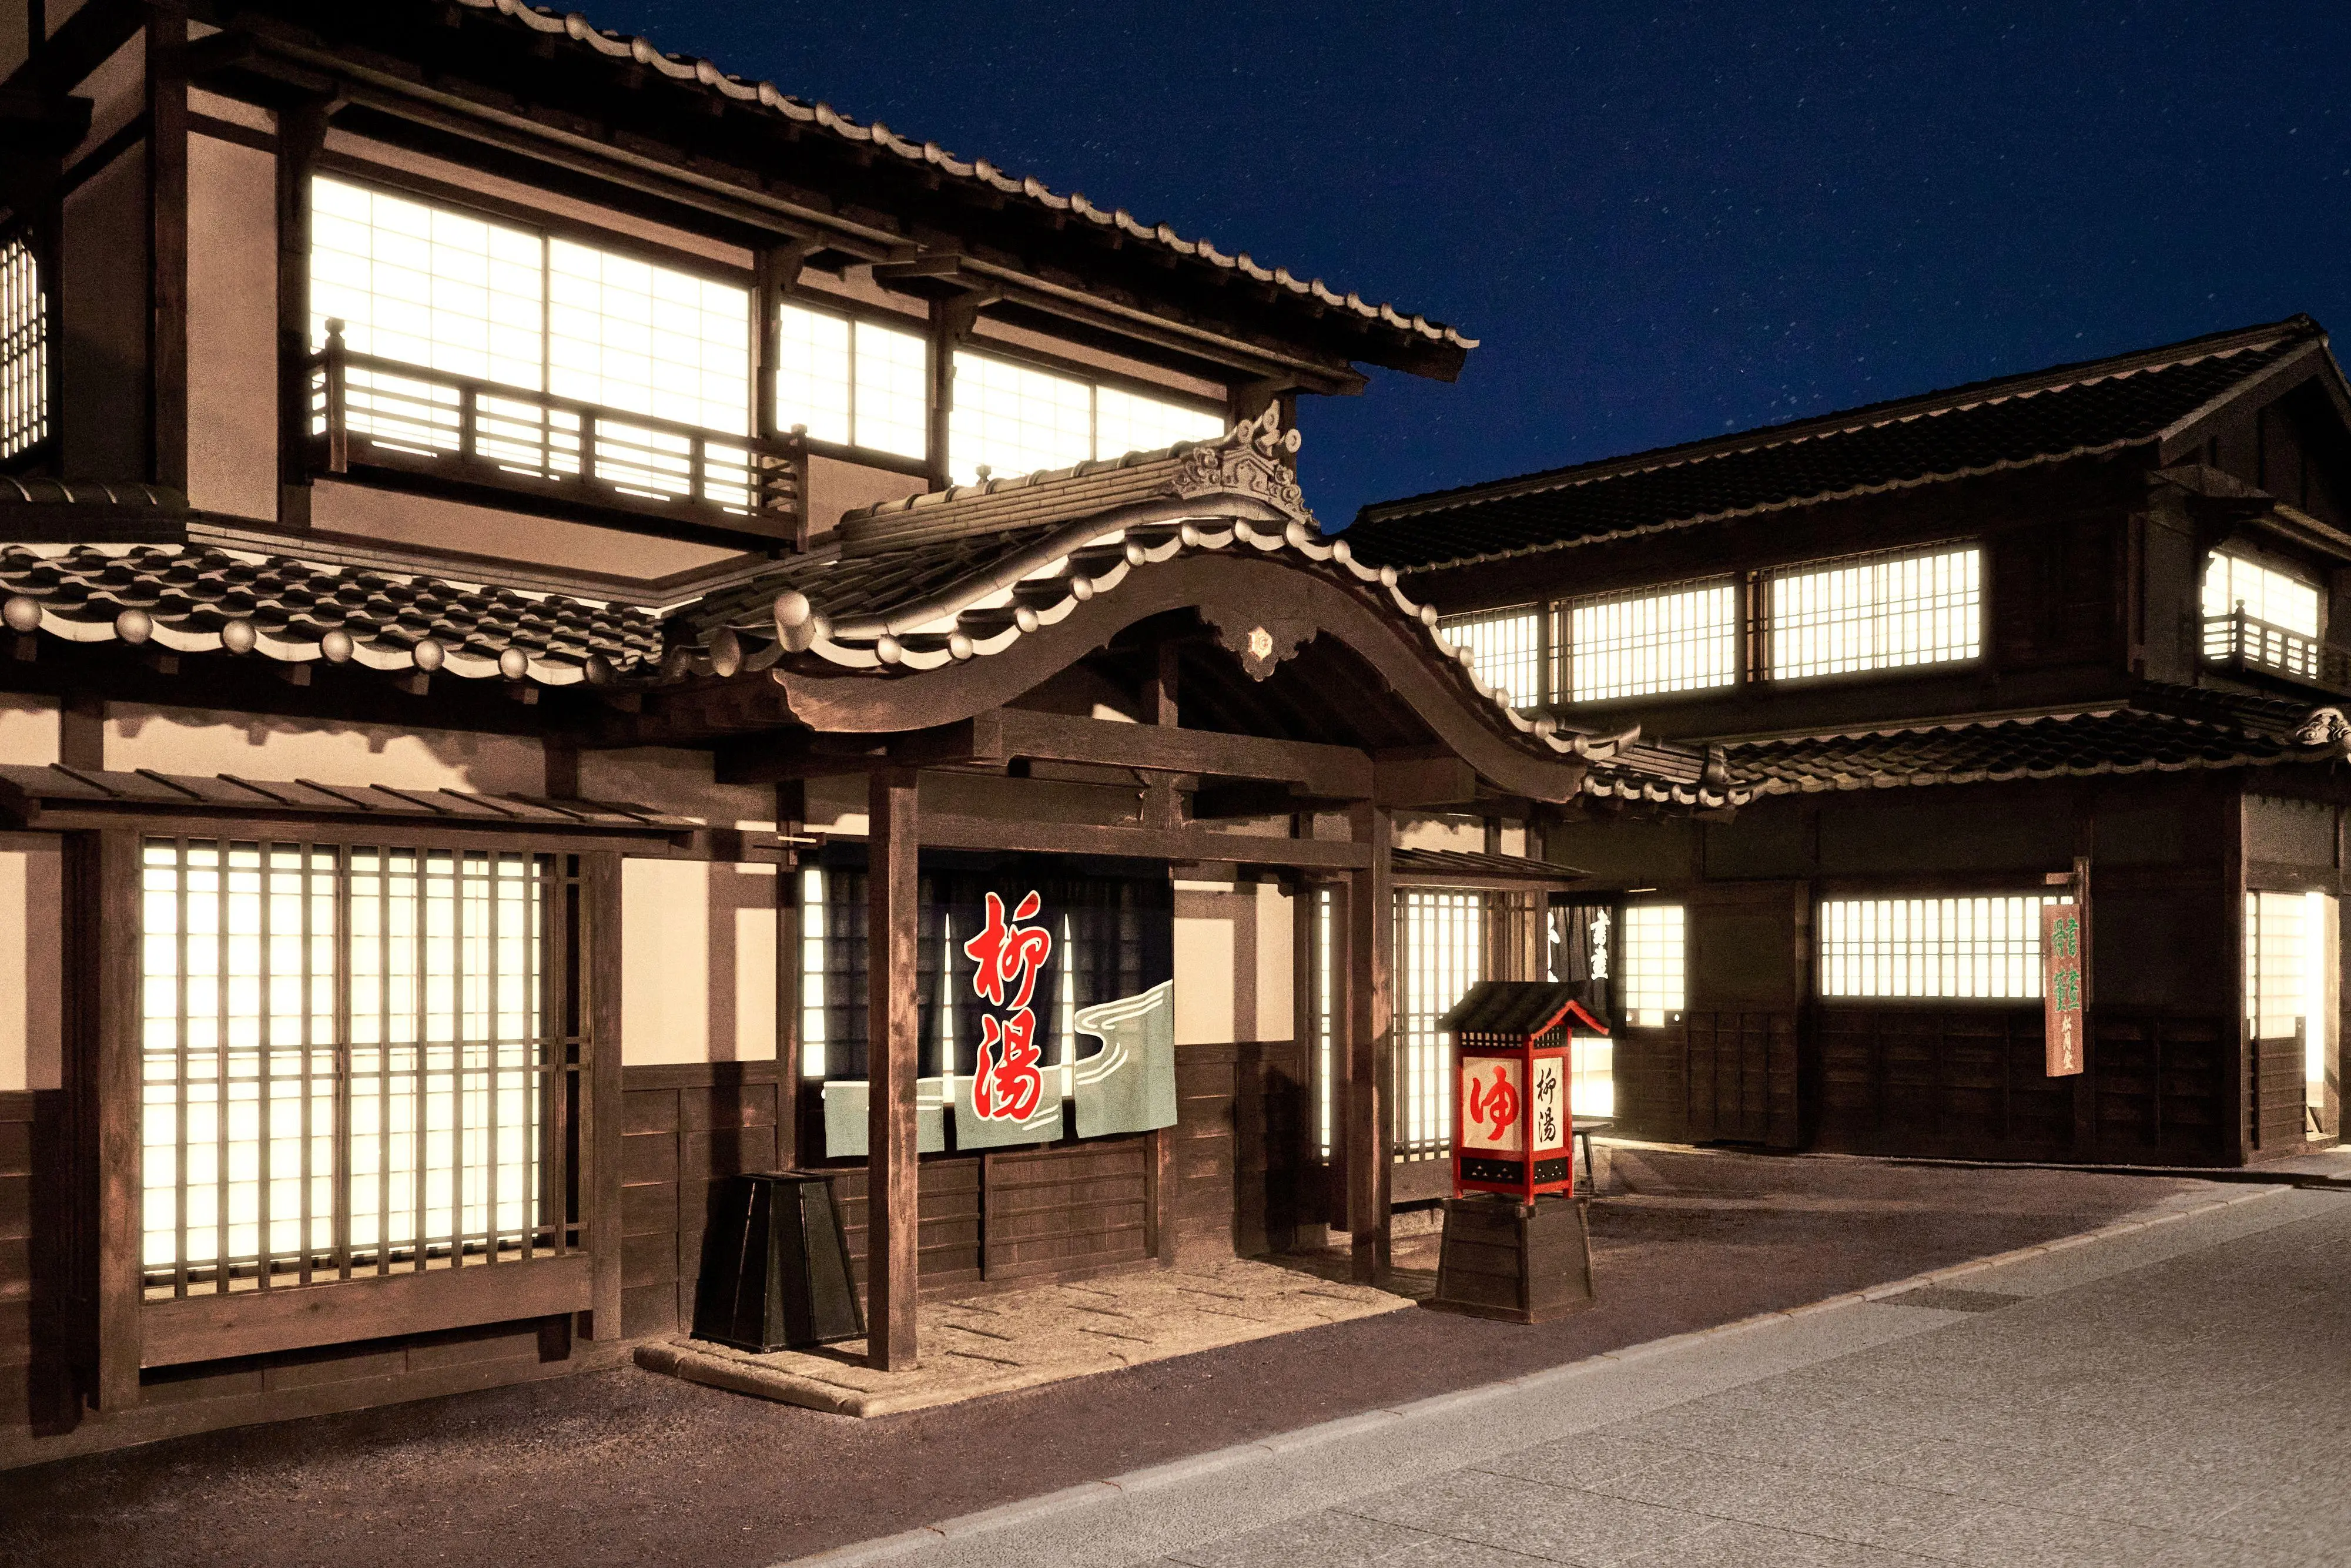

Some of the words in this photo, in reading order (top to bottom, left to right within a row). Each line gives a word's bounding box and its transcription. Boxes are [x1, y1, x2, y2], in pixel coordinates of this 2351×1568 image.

[964, 890, 1051, 1121] 柳湯
[1470, 1065, 1519, 1141] ゆ
[1536, 1067, 1556, 1143] 柳湯
